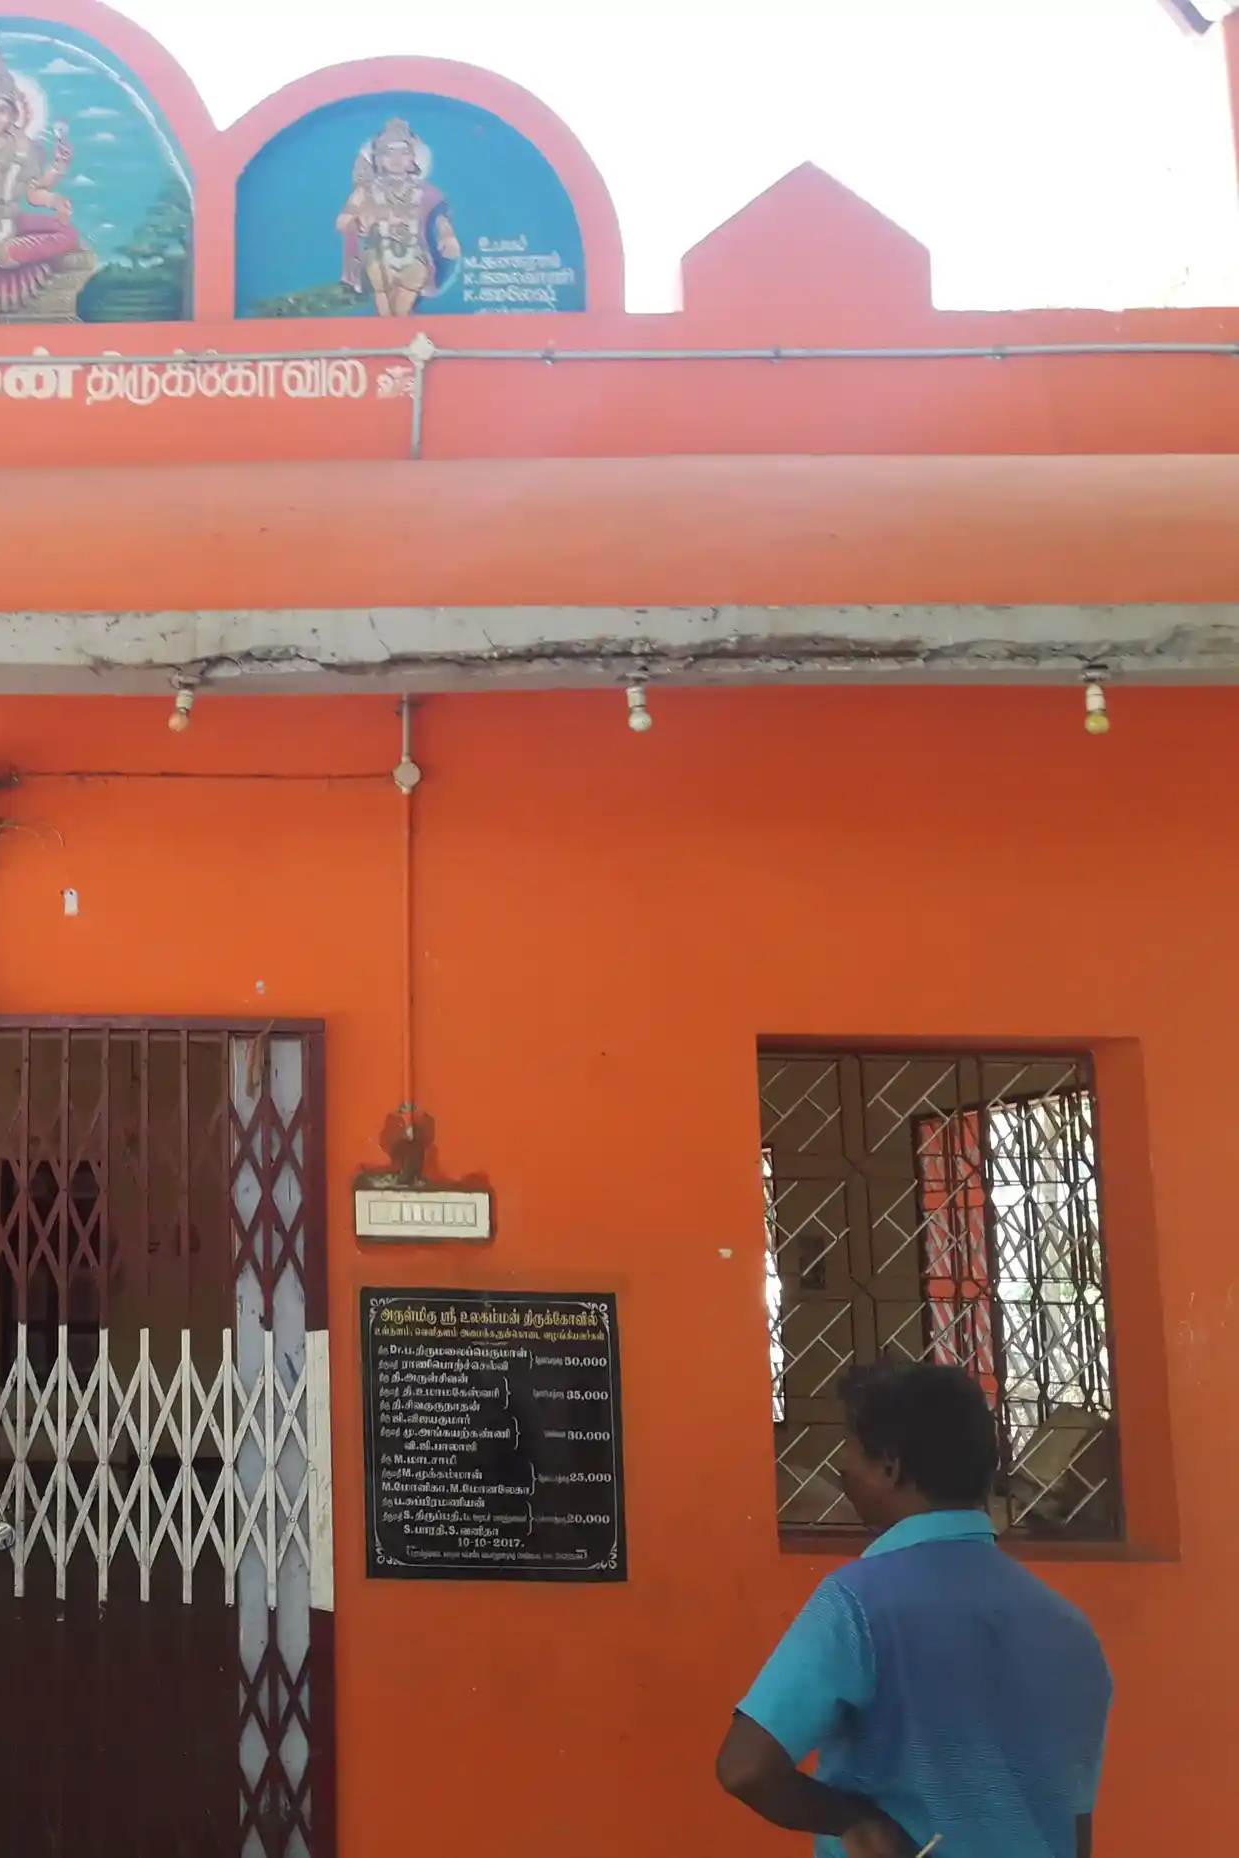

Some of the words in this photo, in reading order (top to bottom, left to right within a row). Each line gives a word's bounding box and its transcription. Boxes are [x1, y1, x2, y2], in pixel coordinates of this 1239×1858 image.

[381, 1304, 438, 1325] அருள்மிகு
[440, 1305, 456, 1326] ஸ்ரீ
[460, 1307, 520, 1325] உலகம்மன்
[523, 1308, 598, 1329] திருக்கோவில்
[564, 1356, 608, 1367] 50,000
[566, 1390, 609, 1401] 35,000
[569, 1472, 612, 1483] 25,000
[568, 1514, 611, 1524] 20,000
